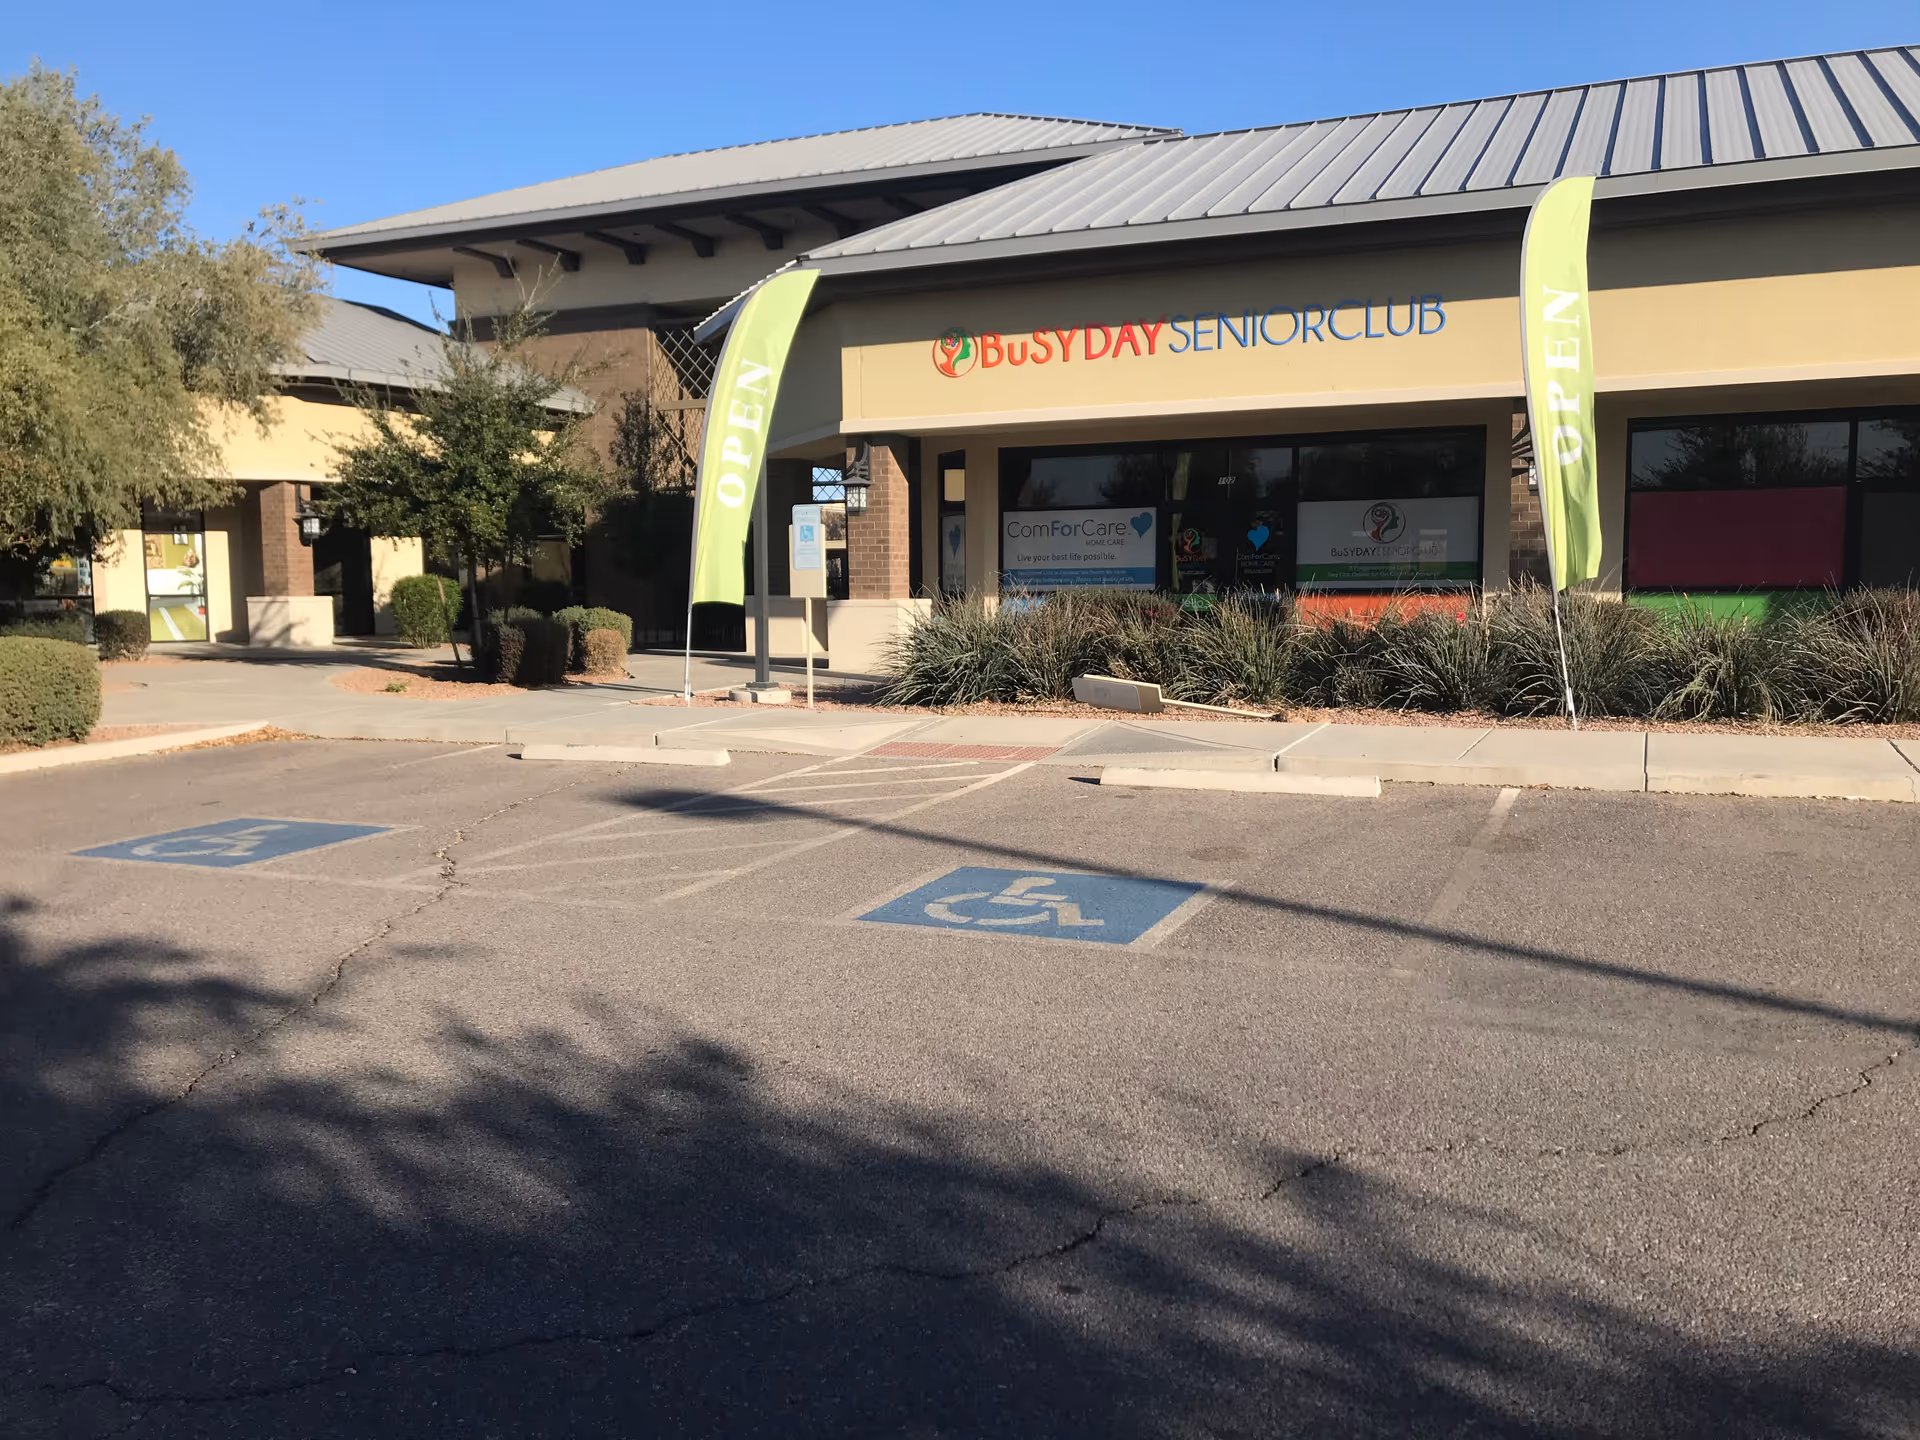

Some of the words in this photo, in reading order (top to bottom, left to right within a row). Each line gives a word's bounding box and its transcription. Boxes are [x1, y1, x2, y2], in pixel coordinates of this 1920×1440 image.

[1542, 284, 1583, 466] OPEN
[716, 357, 773, 508] OPEN
[1007, 519, 1127, 539] ComForCare
[1017, 553, 1031, 562] Live
[1033, 554, 1050, 563] your
[1051, 553, 1068, 561] best
[1069, 552, 1082, 561] life
[1083, 552, 1117, 562] possible.
